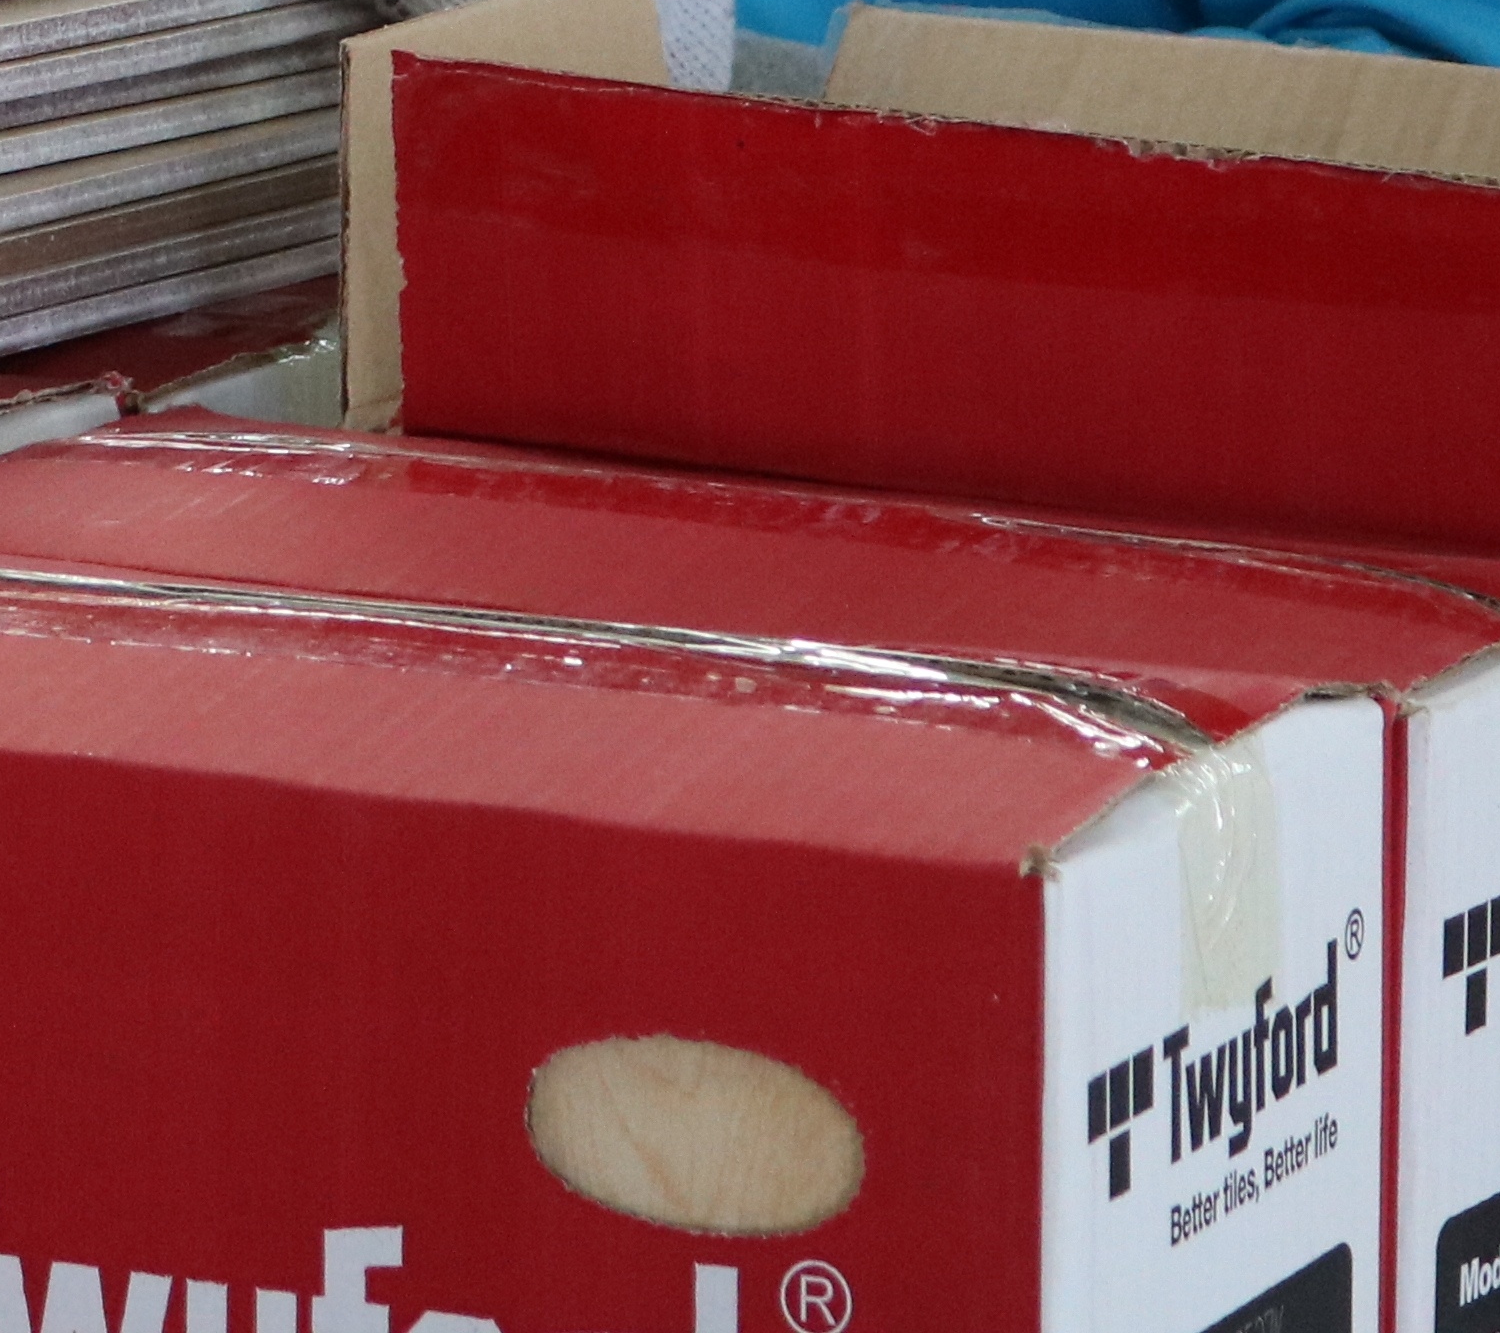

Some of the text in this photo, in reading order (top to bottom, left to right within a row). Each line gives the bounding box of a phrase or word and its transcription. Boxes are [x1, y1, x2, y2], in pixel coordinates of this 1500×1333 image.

[1170, 1111, 1339, 1247] Better tiles, Better life
